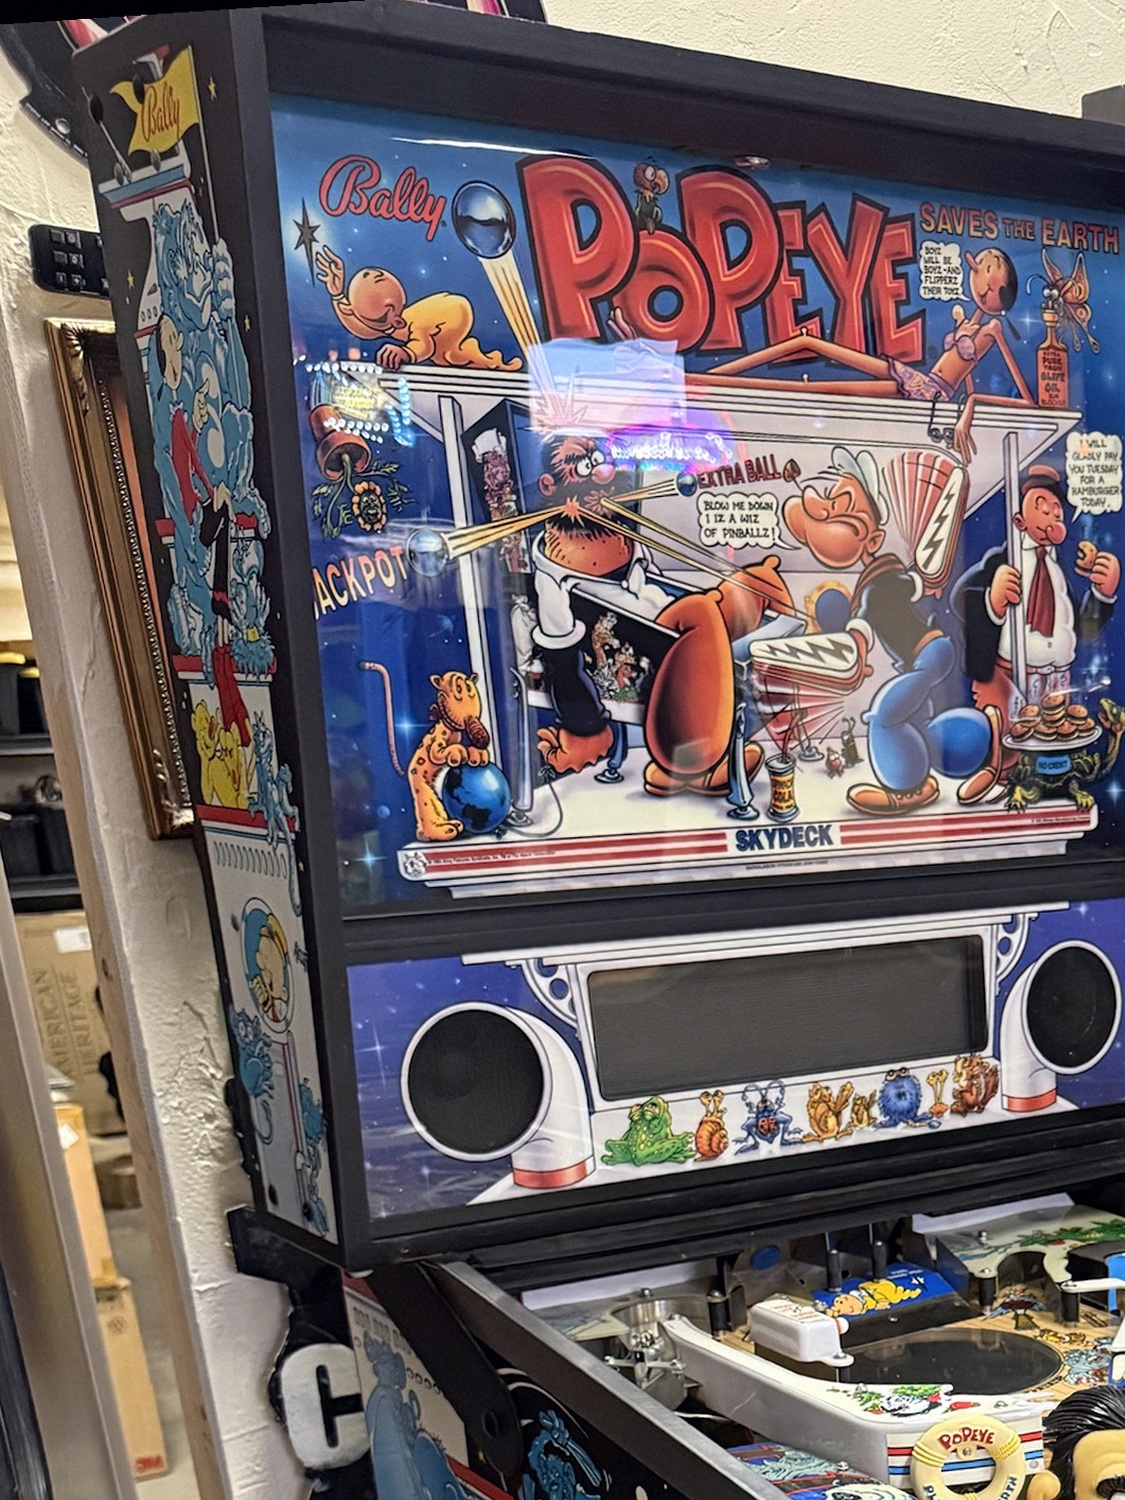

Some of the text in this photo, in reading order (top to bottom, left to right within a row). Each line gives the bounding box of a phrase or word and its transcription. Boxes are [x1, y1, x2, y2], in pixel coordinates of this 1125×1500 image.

[141, 81, 181, 142] Bally
[319, 156, 448, 241] Bally
[919, 202, 1120, 255] SAVES THE EARTH
[924, 246, 942, 255] BOYZ
[516, 153, 927, 366] POPEYE
[923, 256, 952, 265] WILL BE
[1104, 451, 1120, 462] PAY
[697, 453, 783, 490] EXTRA BALL
[1068, 464, 1120, 475] YOU TUESDAY
[1080, 475, 1106, 485] FOR A
[1071, 486, 1120, 497] HAMBURGER
[703, 501, 774, 512] BLOW ME DOWN
[705, 513, 760, 524] I IZ A WIZ
[703, 528, 718, 539] OF
[314, 546, 408, 621] ACKPOT
[735, 824, 835, 852] SKYDECK
[937, 1426, 995, 1450] POPEYE
